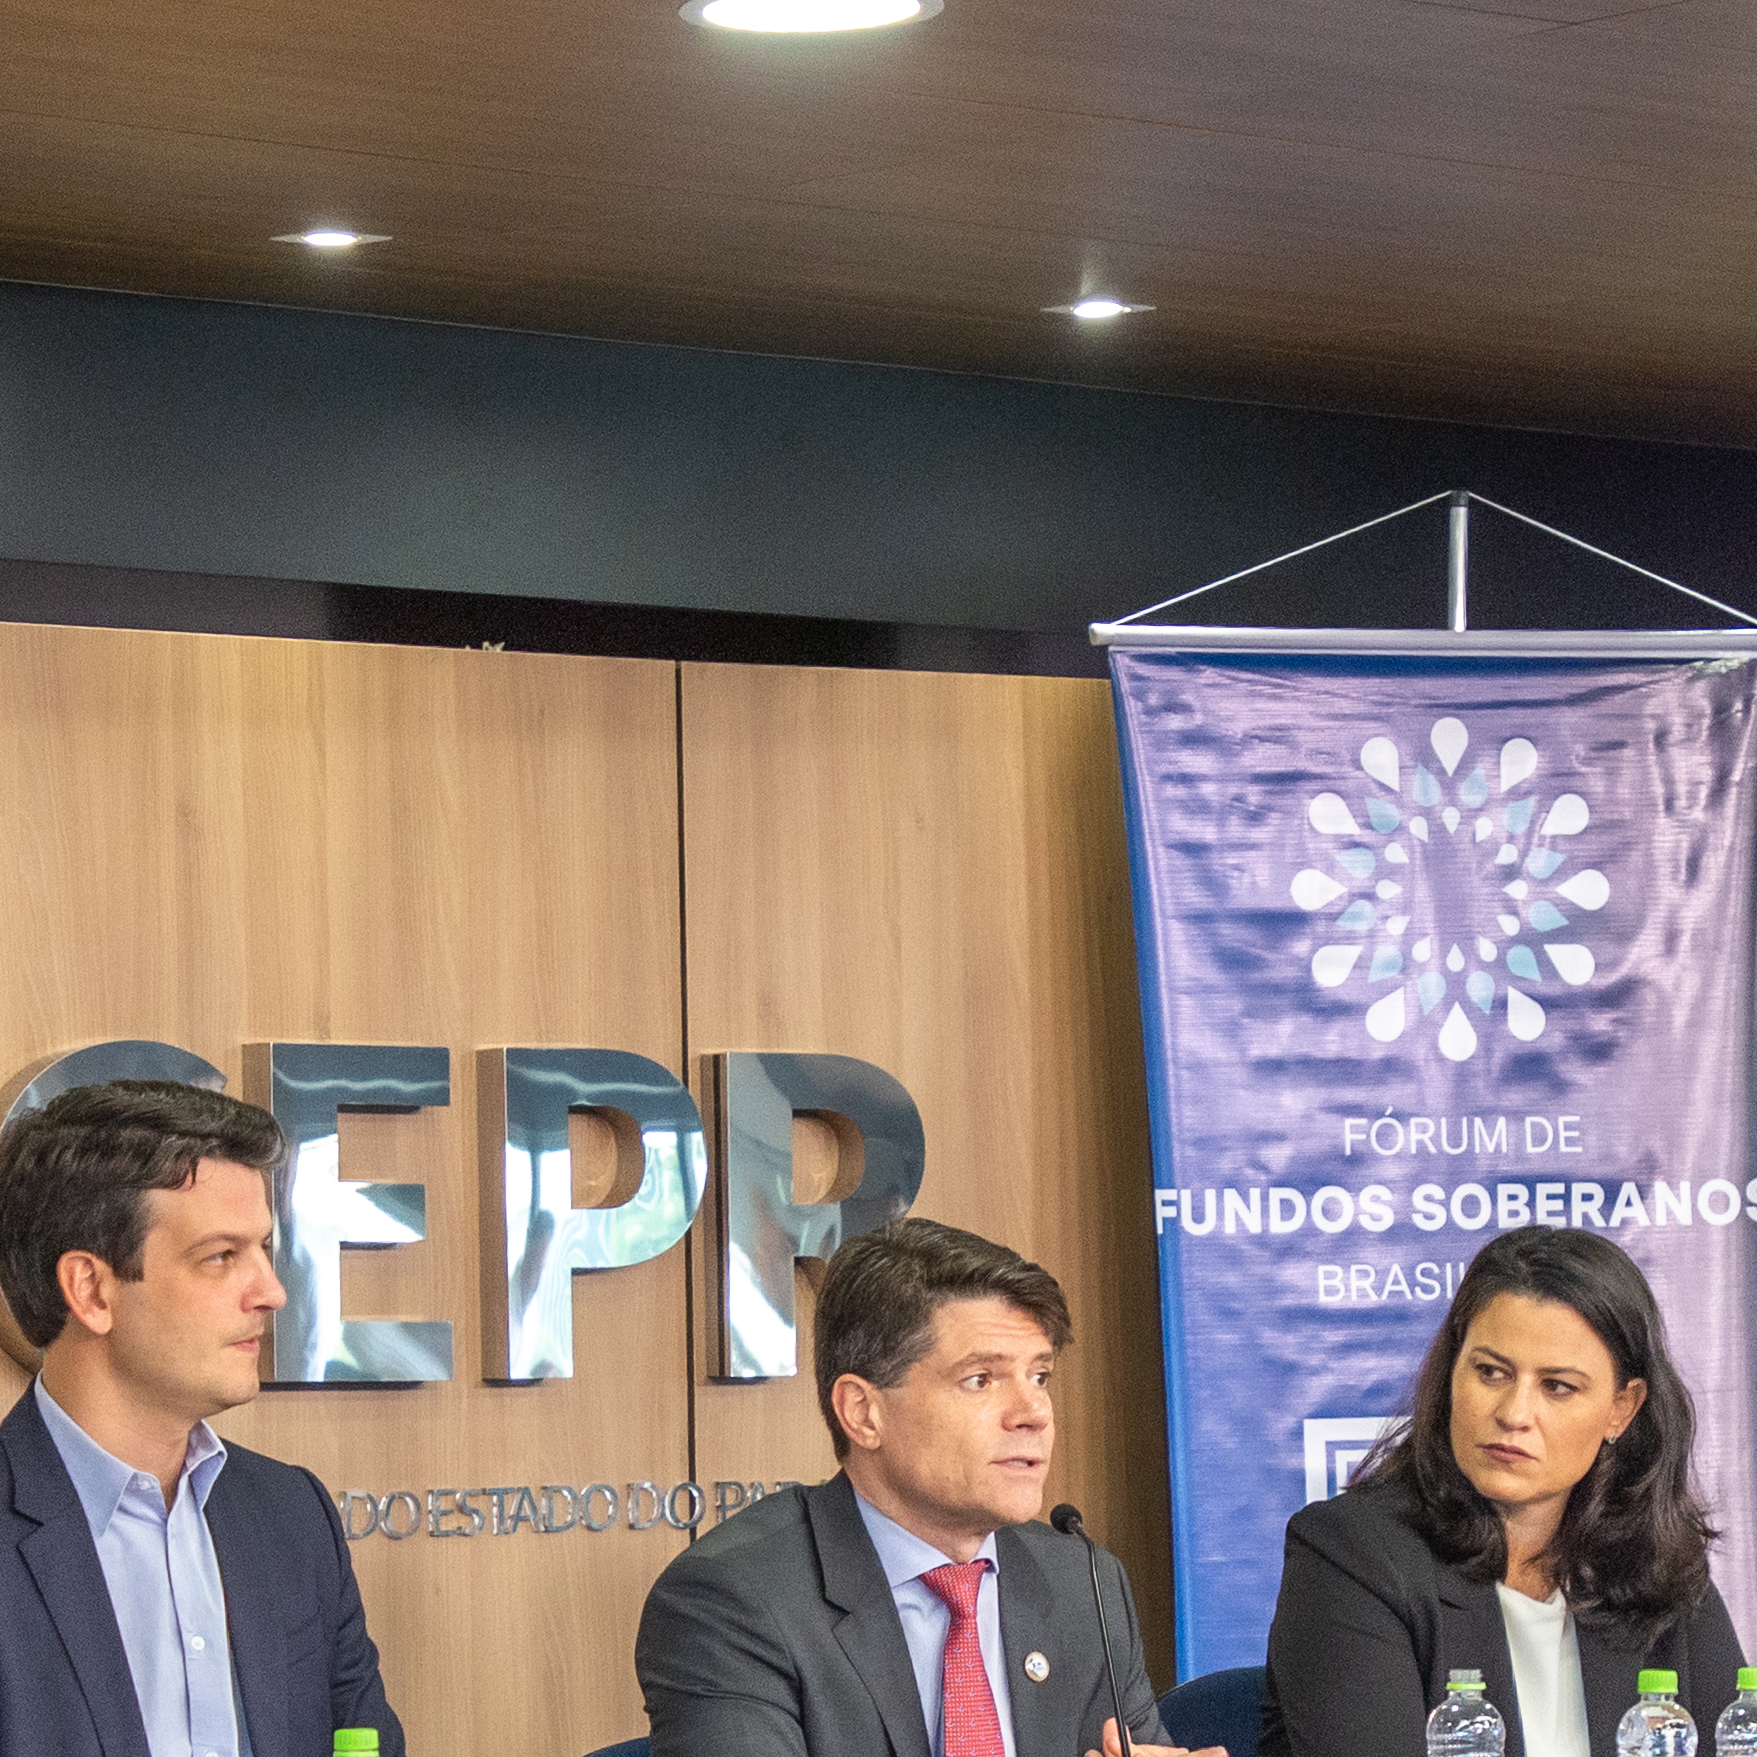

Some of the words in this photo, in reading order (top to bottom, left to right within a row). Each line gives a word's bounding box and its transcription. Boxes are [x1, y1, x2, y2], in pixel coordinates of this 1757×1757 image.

[1344, 1107, 1510, 1158] FÓRUM
[1524, 1114, 1583, 1153] DE
[1154, 1184, 1395, 1236] FUNDOS
[427, 1483, 620, 1539] ESTADO
[626, 1480, 706, 1531] DO
